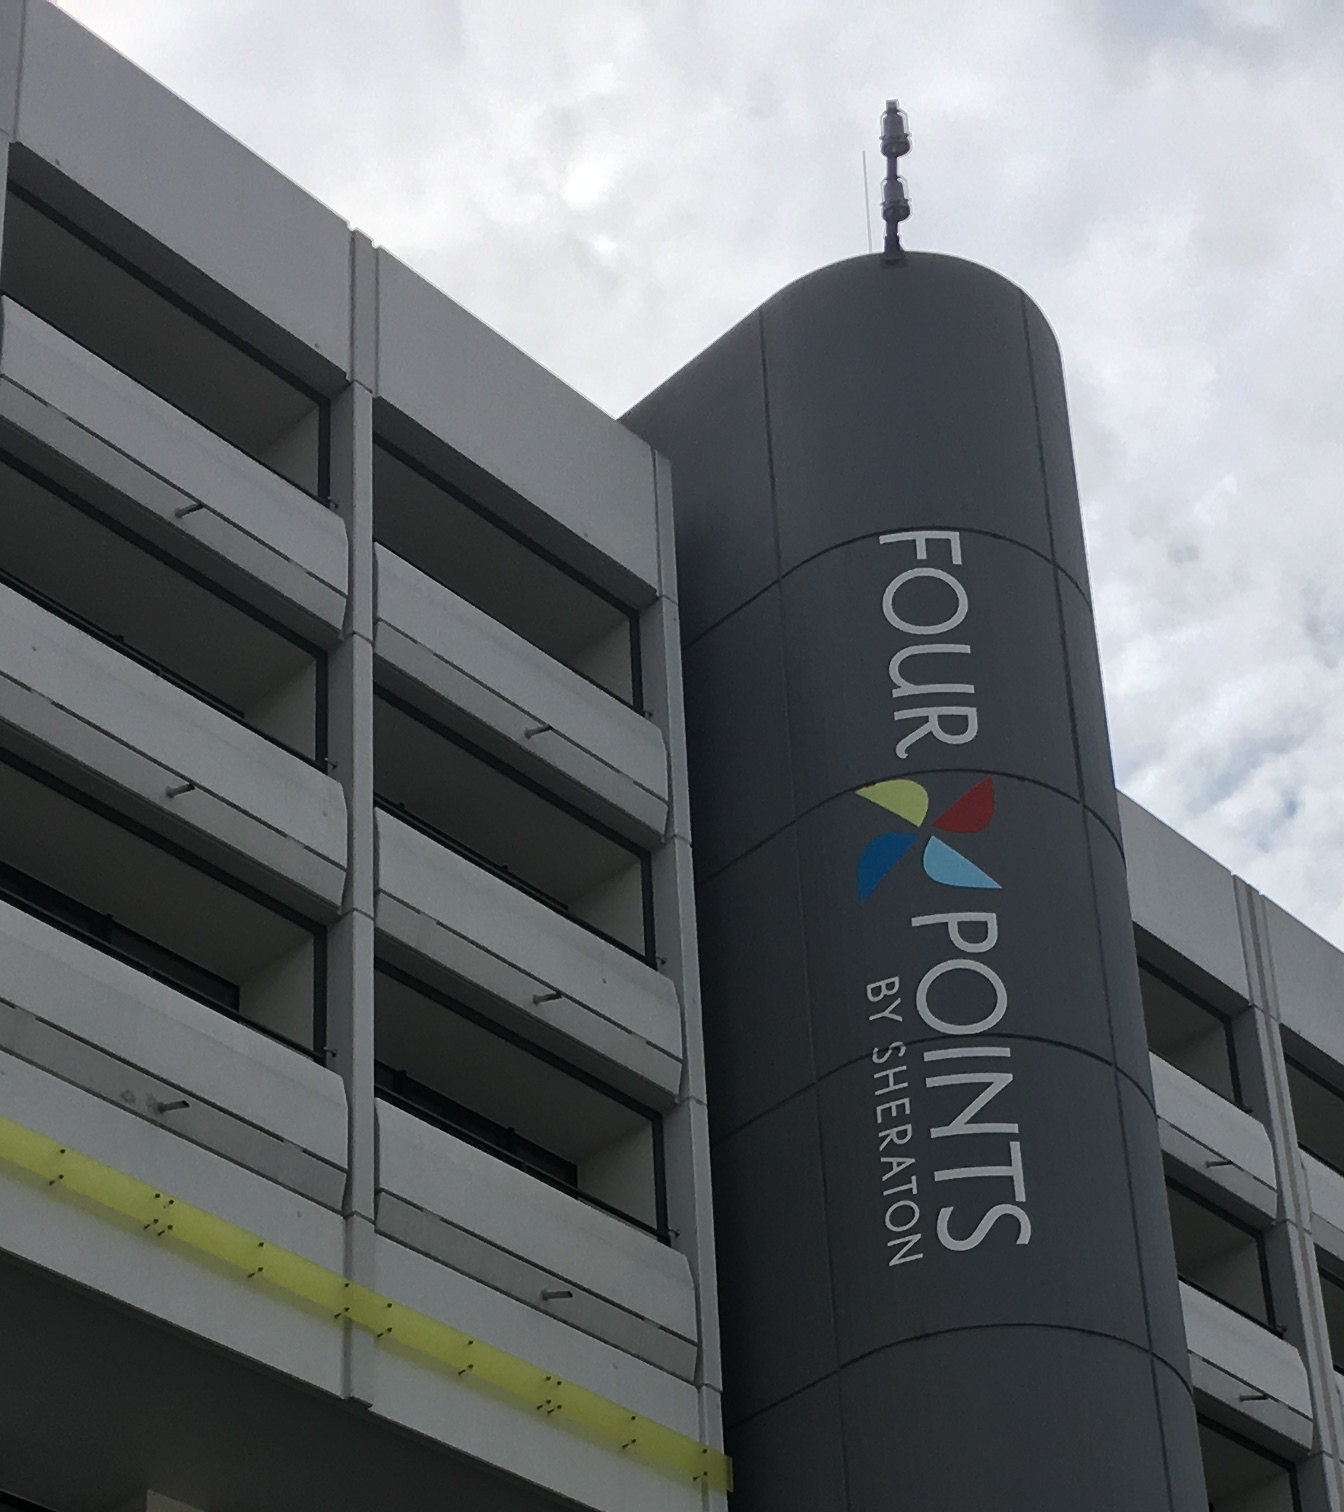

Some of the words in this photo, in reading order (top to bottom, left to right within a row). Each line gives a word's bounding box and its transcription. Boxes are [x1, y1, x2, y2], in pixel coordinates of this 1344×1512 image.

[878, 529, 978, 759] FOUR
[865, 975, 904, 1023] BY
[910, 911, 1032, 1252] POINTS
[871, 1040, 924, 1268] SHERATON
